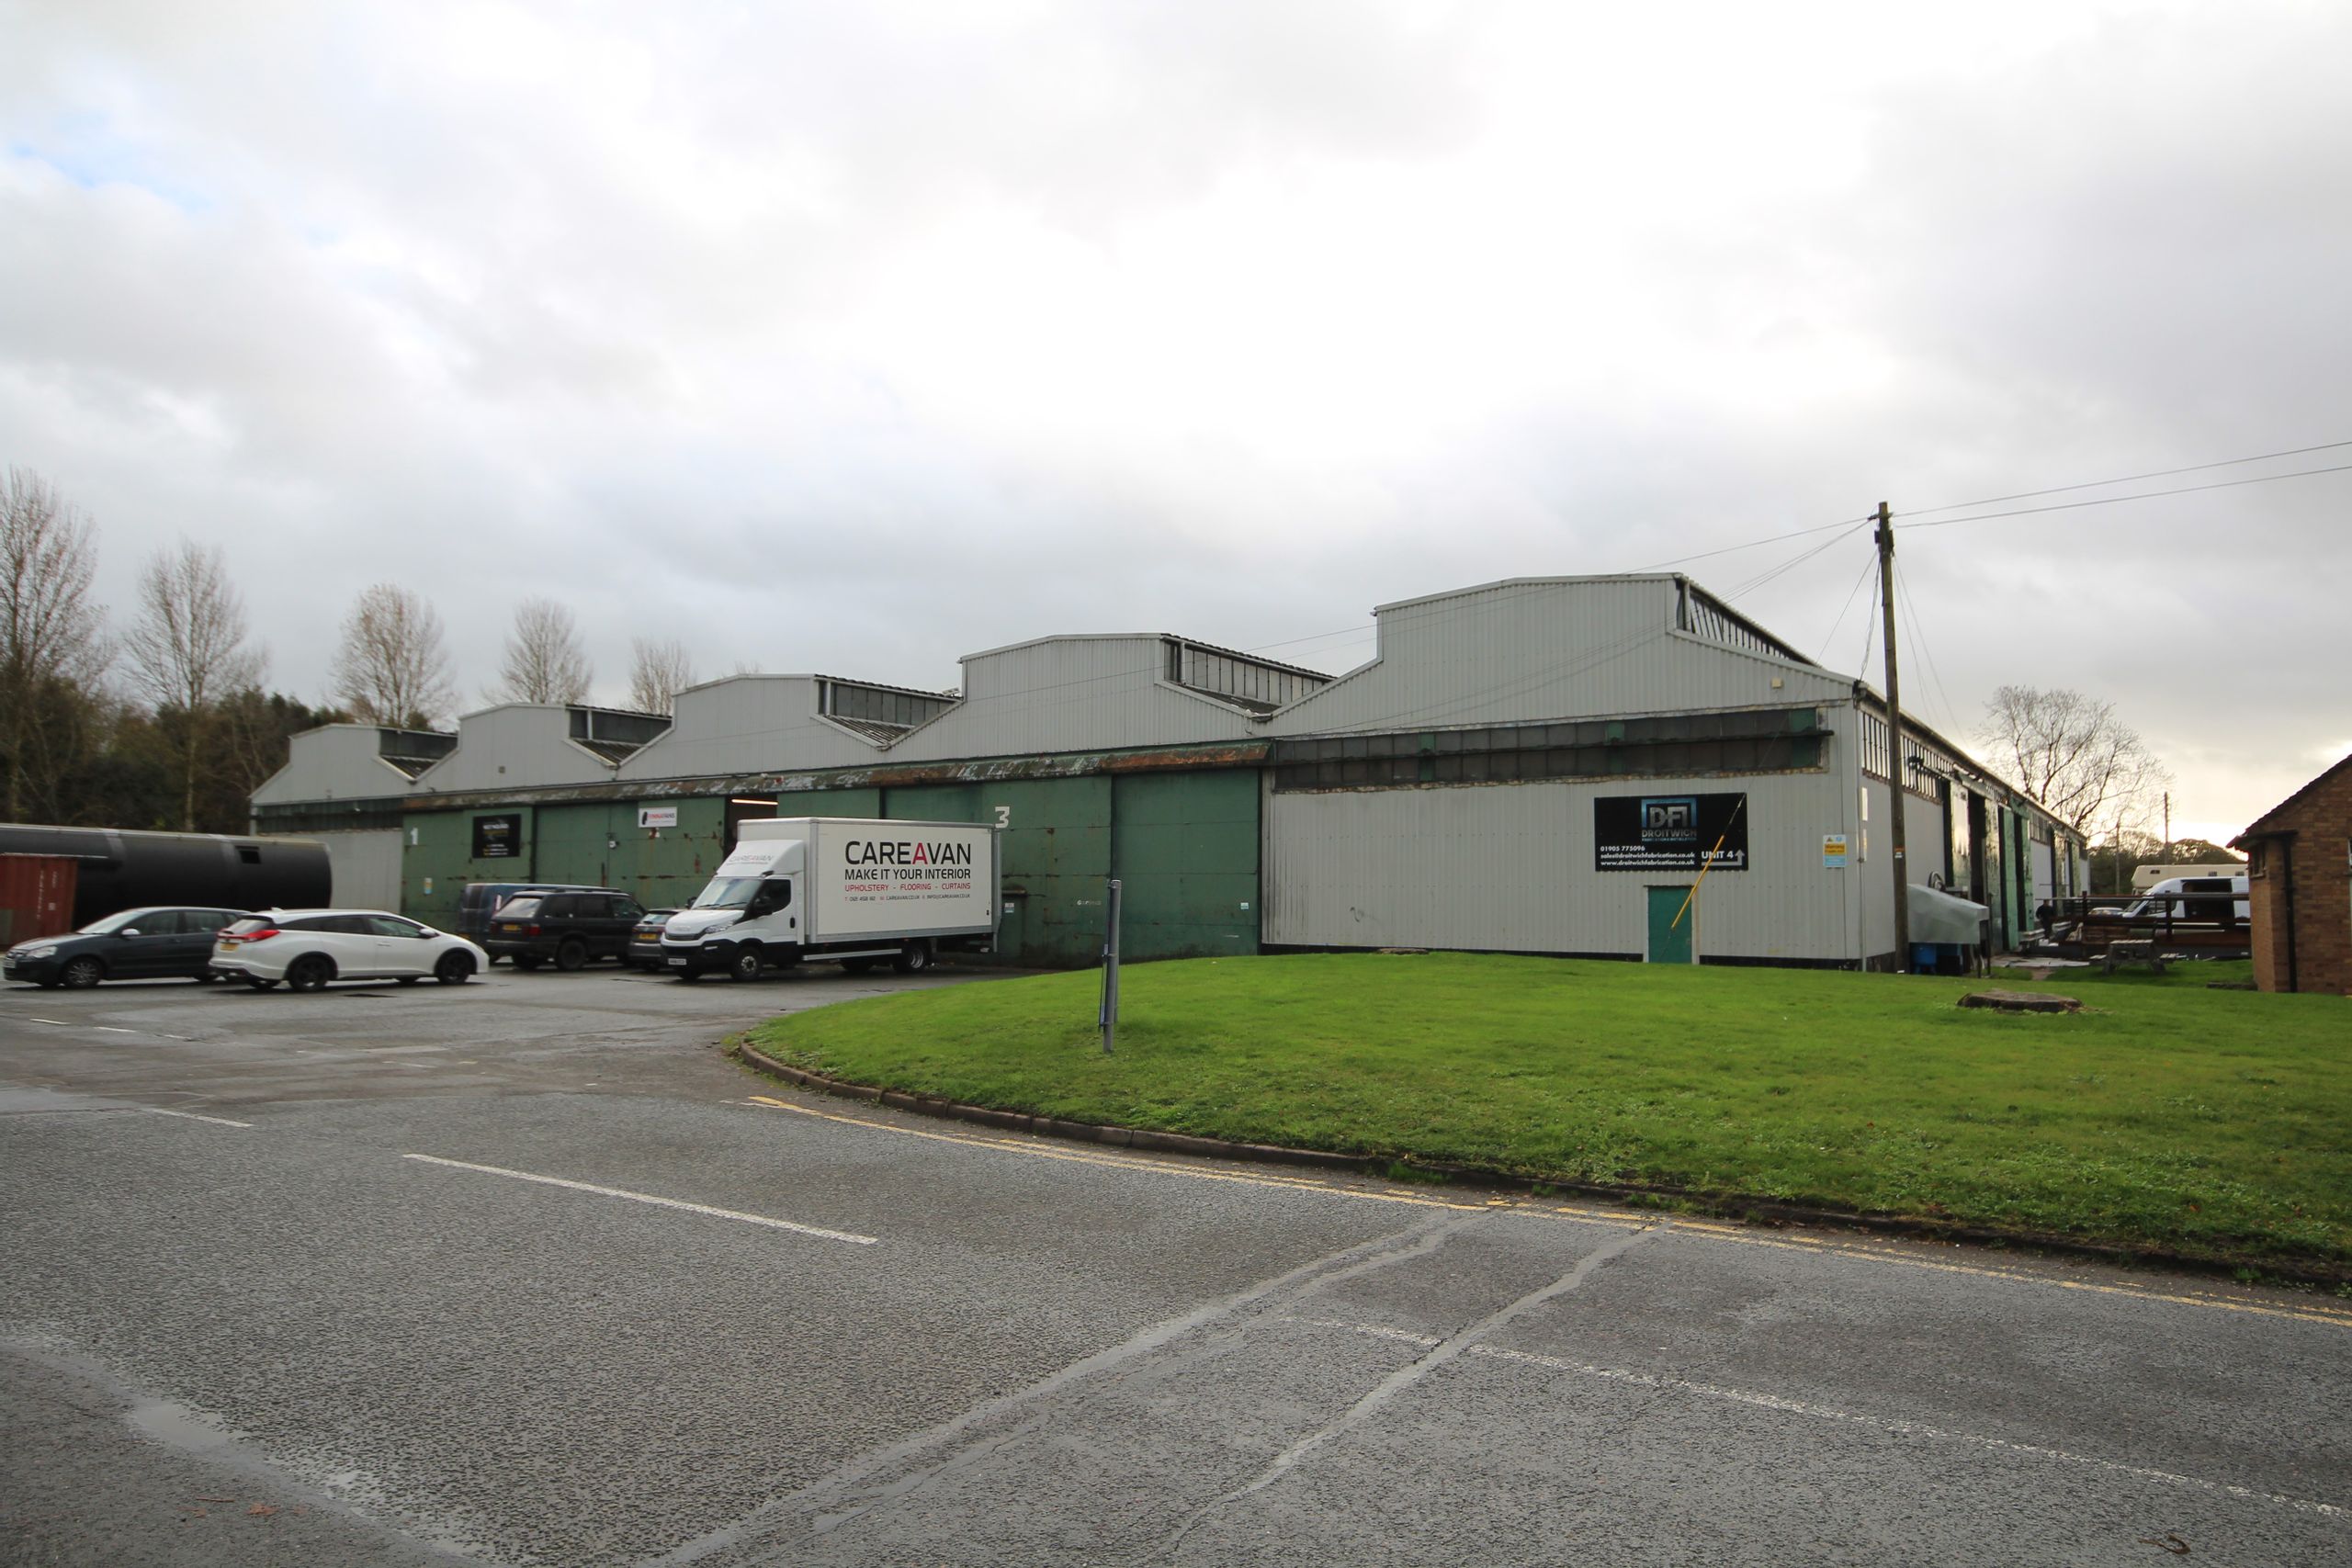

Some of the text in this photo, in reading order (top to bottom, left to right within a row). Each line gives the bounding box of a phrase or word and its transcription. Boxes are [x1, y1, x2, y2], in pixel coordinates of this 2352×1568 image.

[995, 807, 1011, 829] 3
[410, 827, 419, 845] 1
[1641, 829, 1698, 838] DROITWICH
[844, 840, 971, 865] CAREAVAN
[1702, 851, 1734, 859] UNIT 4
[844, 868, 971, 880] MAKE IT YOUR INTERIOR
[844, 884, 888, 892] UPHOLSTERY
[899, 883, 932, 891] FLOORING
[941, 882, 971, 890] CURTAINS
